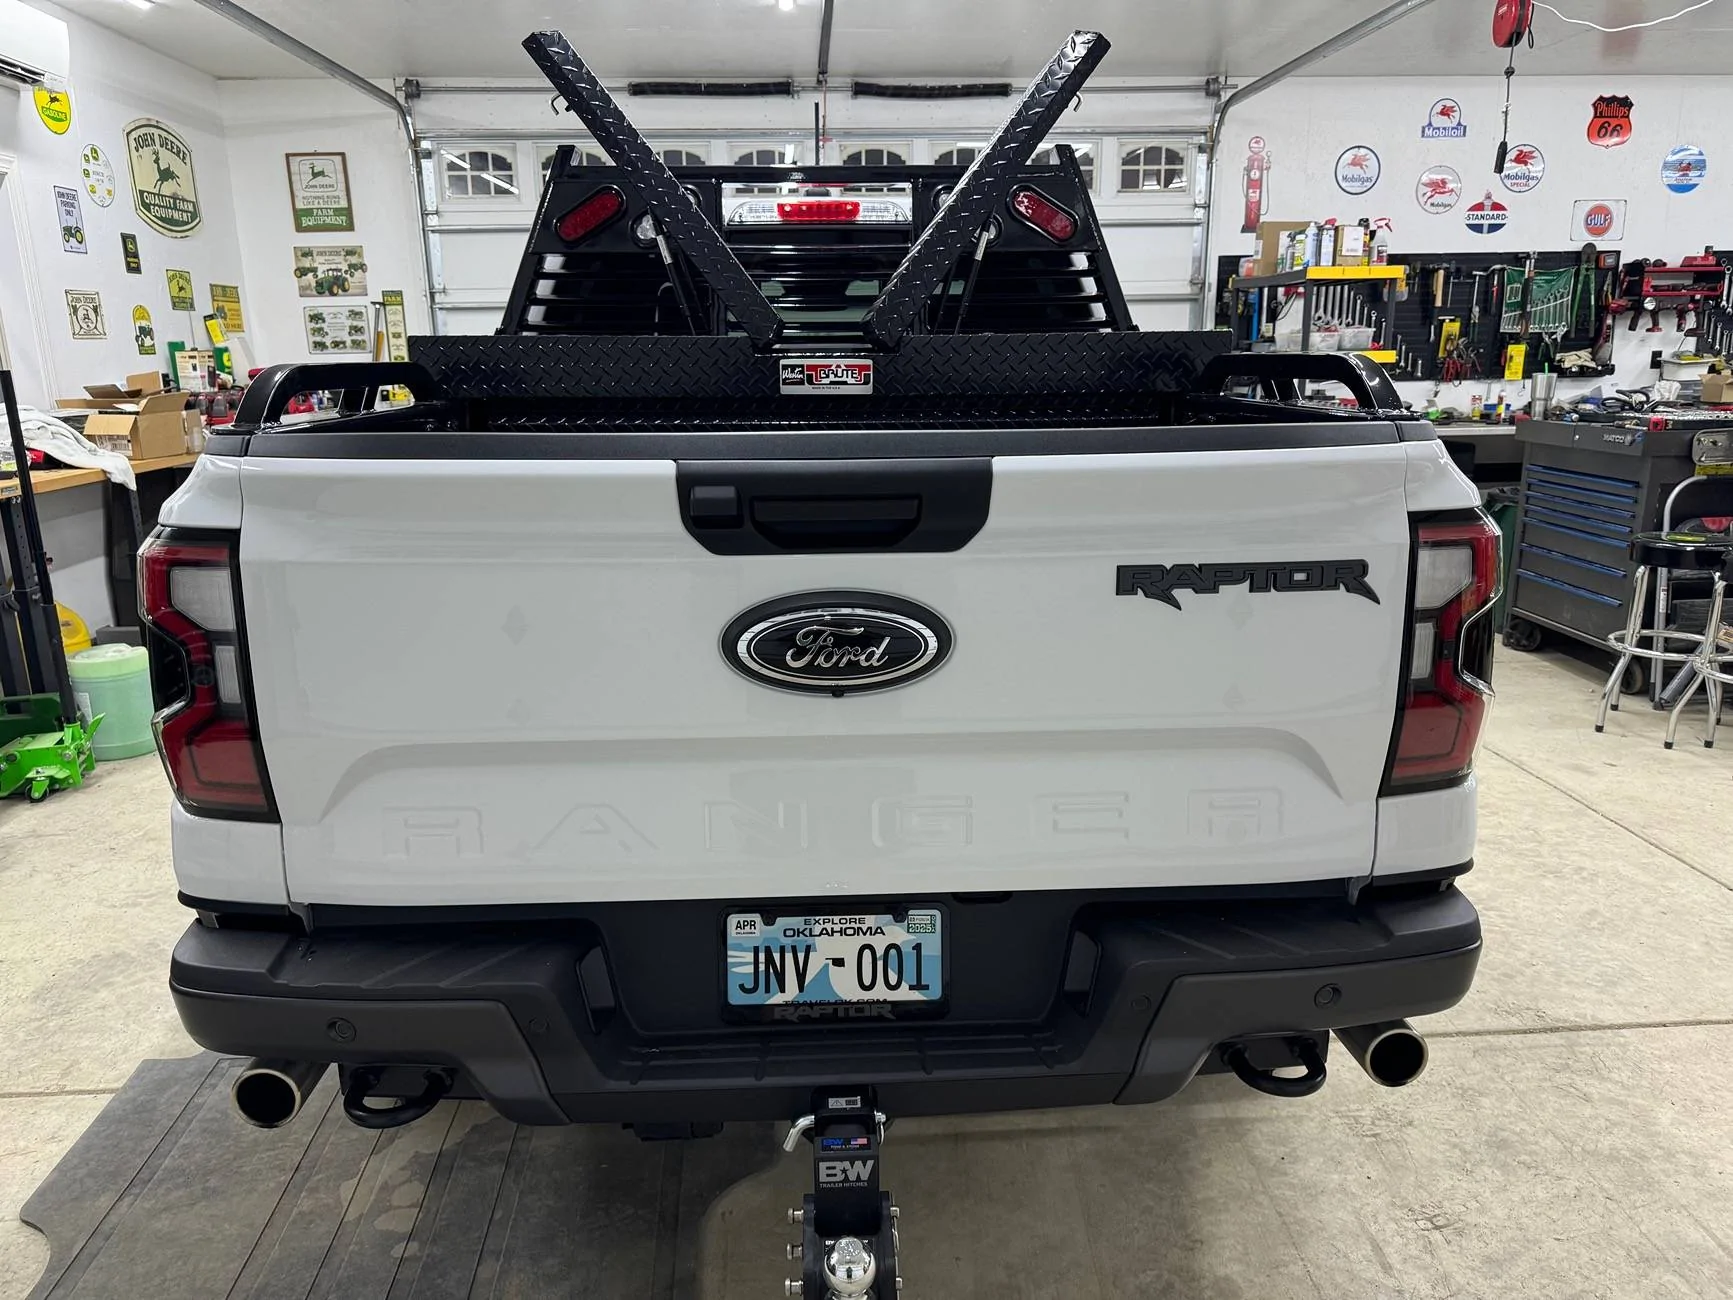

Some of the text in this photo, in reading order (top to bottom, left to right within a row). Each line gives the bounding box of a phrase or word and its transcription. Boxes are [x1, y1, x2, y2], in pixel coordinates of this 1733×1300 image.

[1595, 101, 1629, 119] Phillips
[1424, 126, 1463, 137] Mobiloil
[1597, 121, 1623, 138] 66
[134, 132, 187, 166] JOHN DEERE
[1342, 175, 1374, 185] Mobilgas
[1503, 172, 1538, 182] Mobilgas
[143, 192, 194, 212] QUALITY FARM
[150, 205, 191, 222] EQUIPMENT
[1466, 213, 1507, 221] STANDARD
[1586, 213, 1611, 227] GULF
[301, 216, 347, 227] EQUIPMENT
[782, 367, 804, 379] Westin
[818, 367, 860, 381] BRUTE
[1116, 559, 1380, 611] RAPTOR
[785, 625, 891, 669] Ford
[380, 788, 1285, 857] RANGER
[735, 919, 757, 930] APR
[803, 917, 866, 926] EXPLORE
[909, 923, 932, 933] 2025
[783, 926, 886, 938] OKLAHOMA
[774, 1004, 896, 1022] RAPTOR
